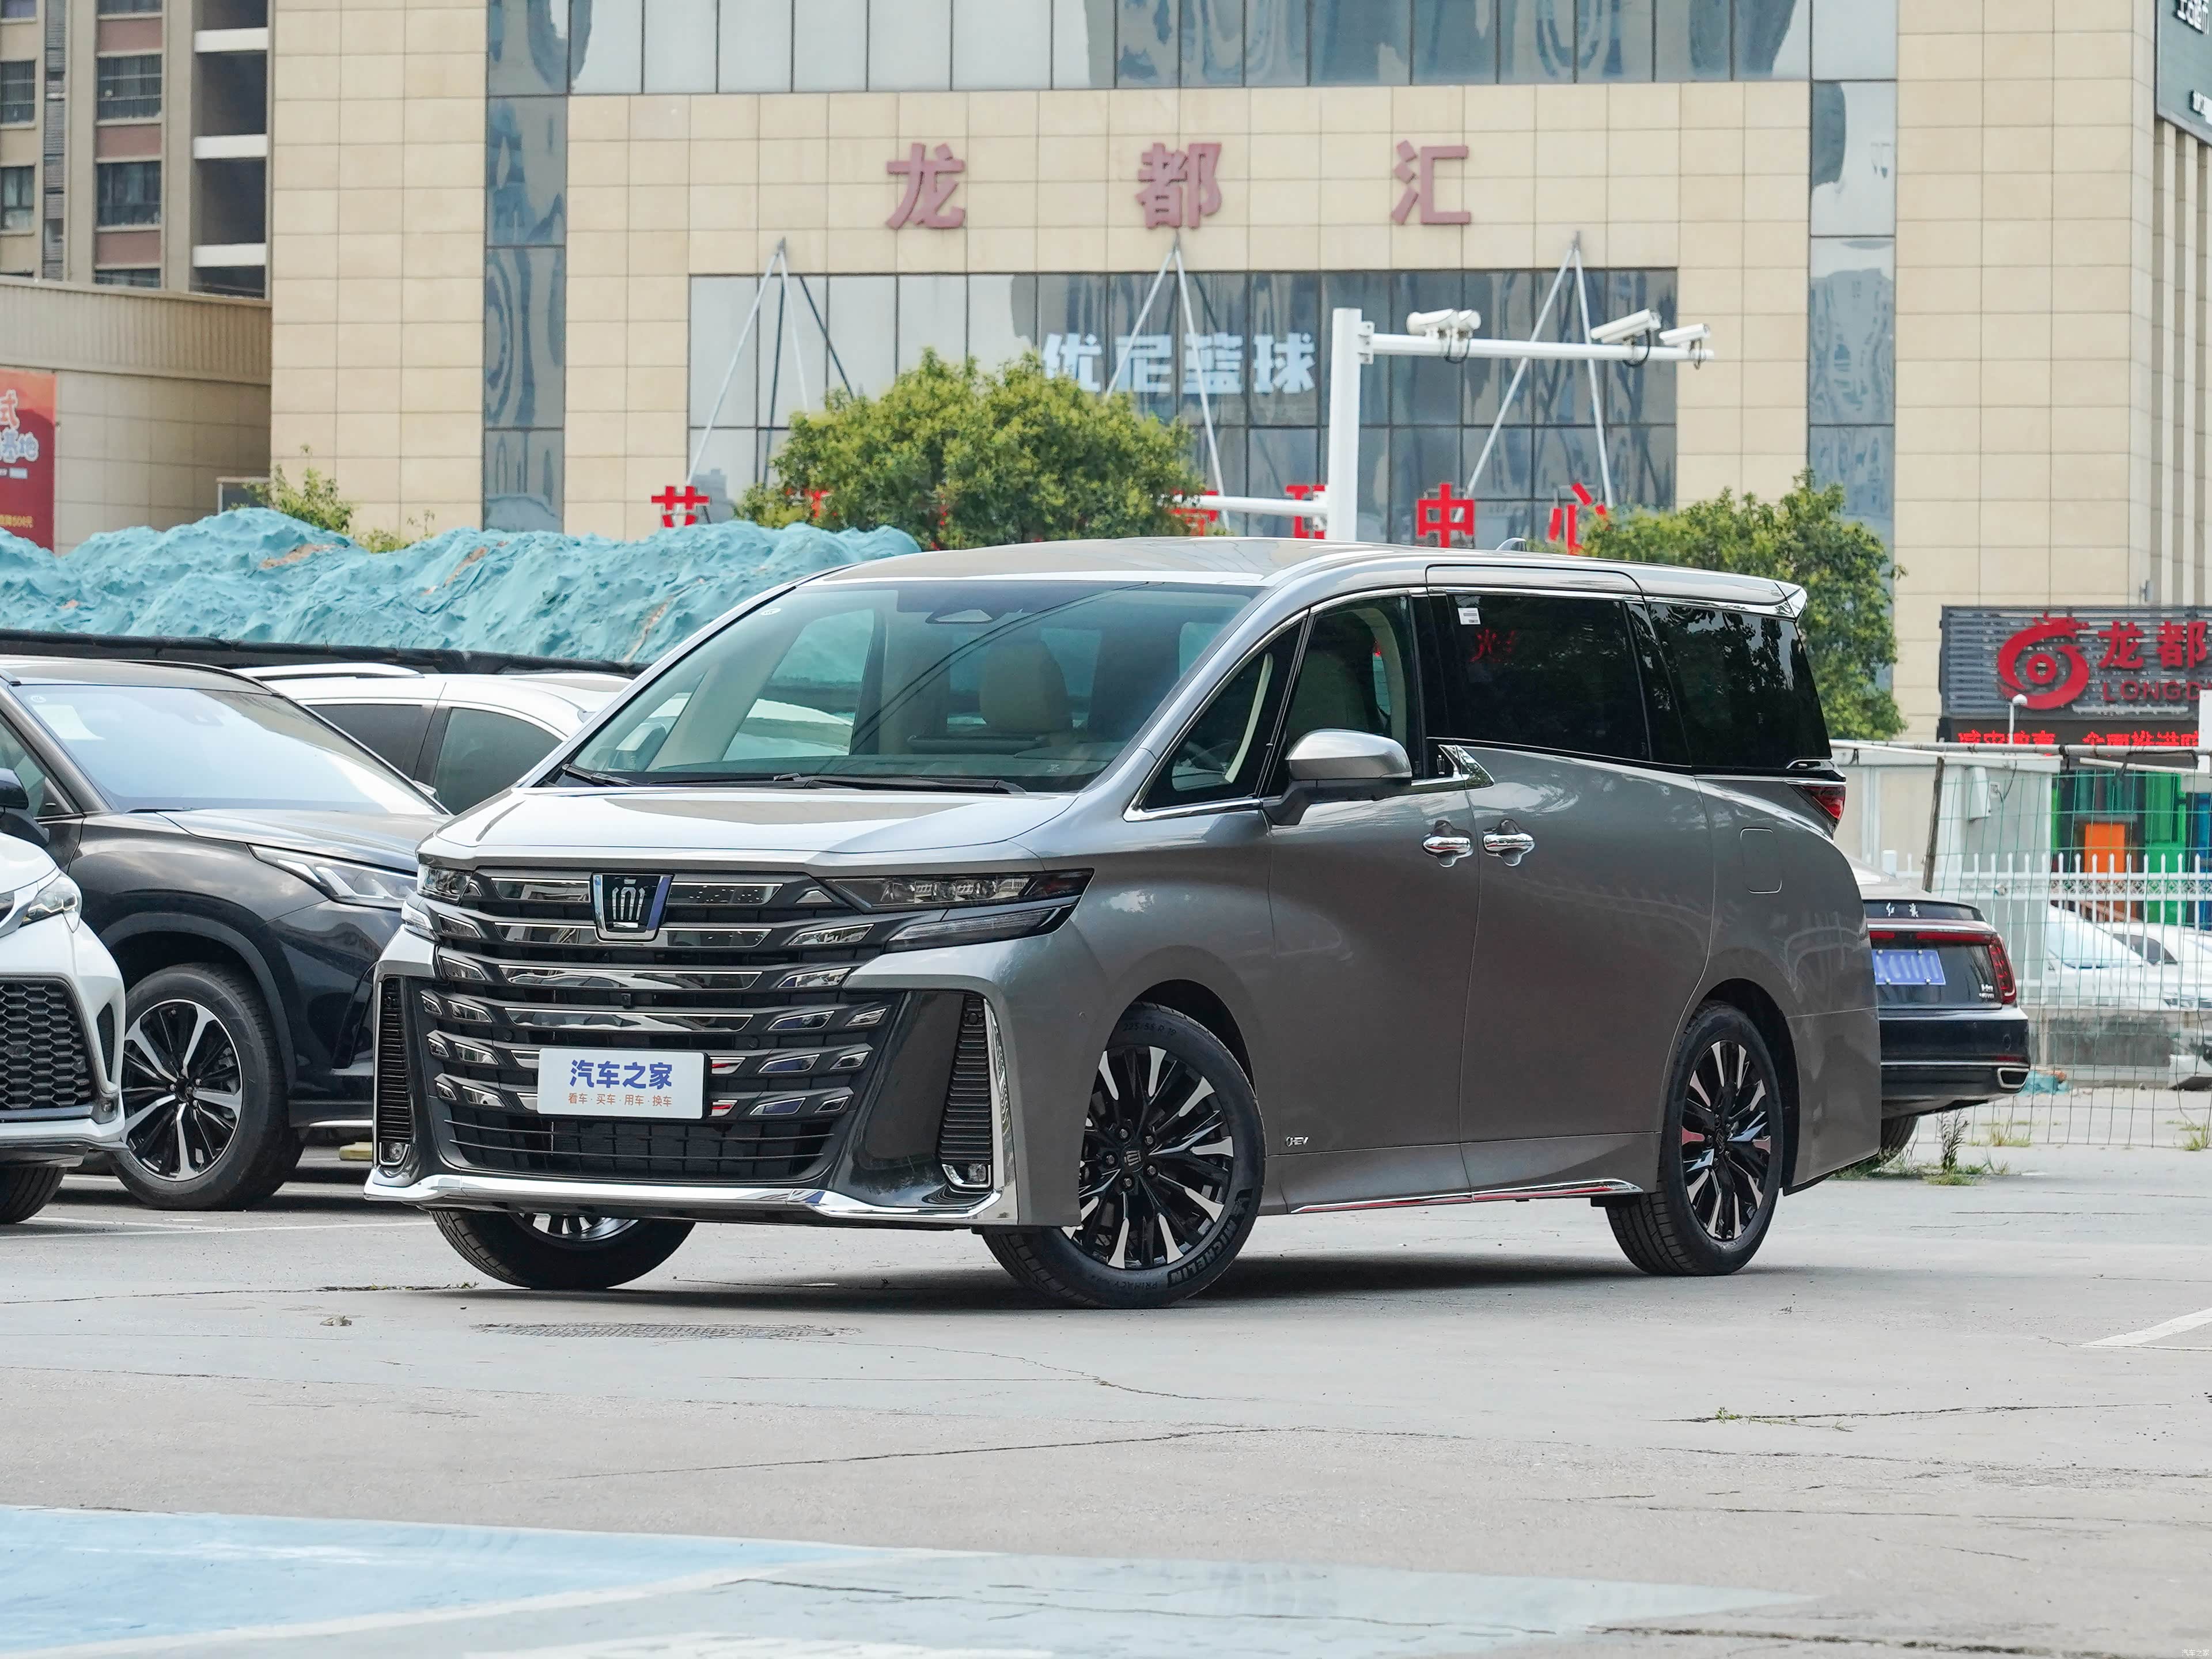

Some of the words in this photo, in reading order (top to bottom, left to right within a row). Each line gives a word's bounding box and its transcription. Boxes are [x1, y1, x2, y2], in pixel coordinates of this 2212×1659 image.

[887, 139, 1471, 230] 龙都汇
[2098, 620, 2207, 668] 龙都
[2103, 680, 2212, 701] LONGD
[569, 1059, 673, 1090] 汽车之家
[1170, 1218, 1238, 1282] MICHELIN
